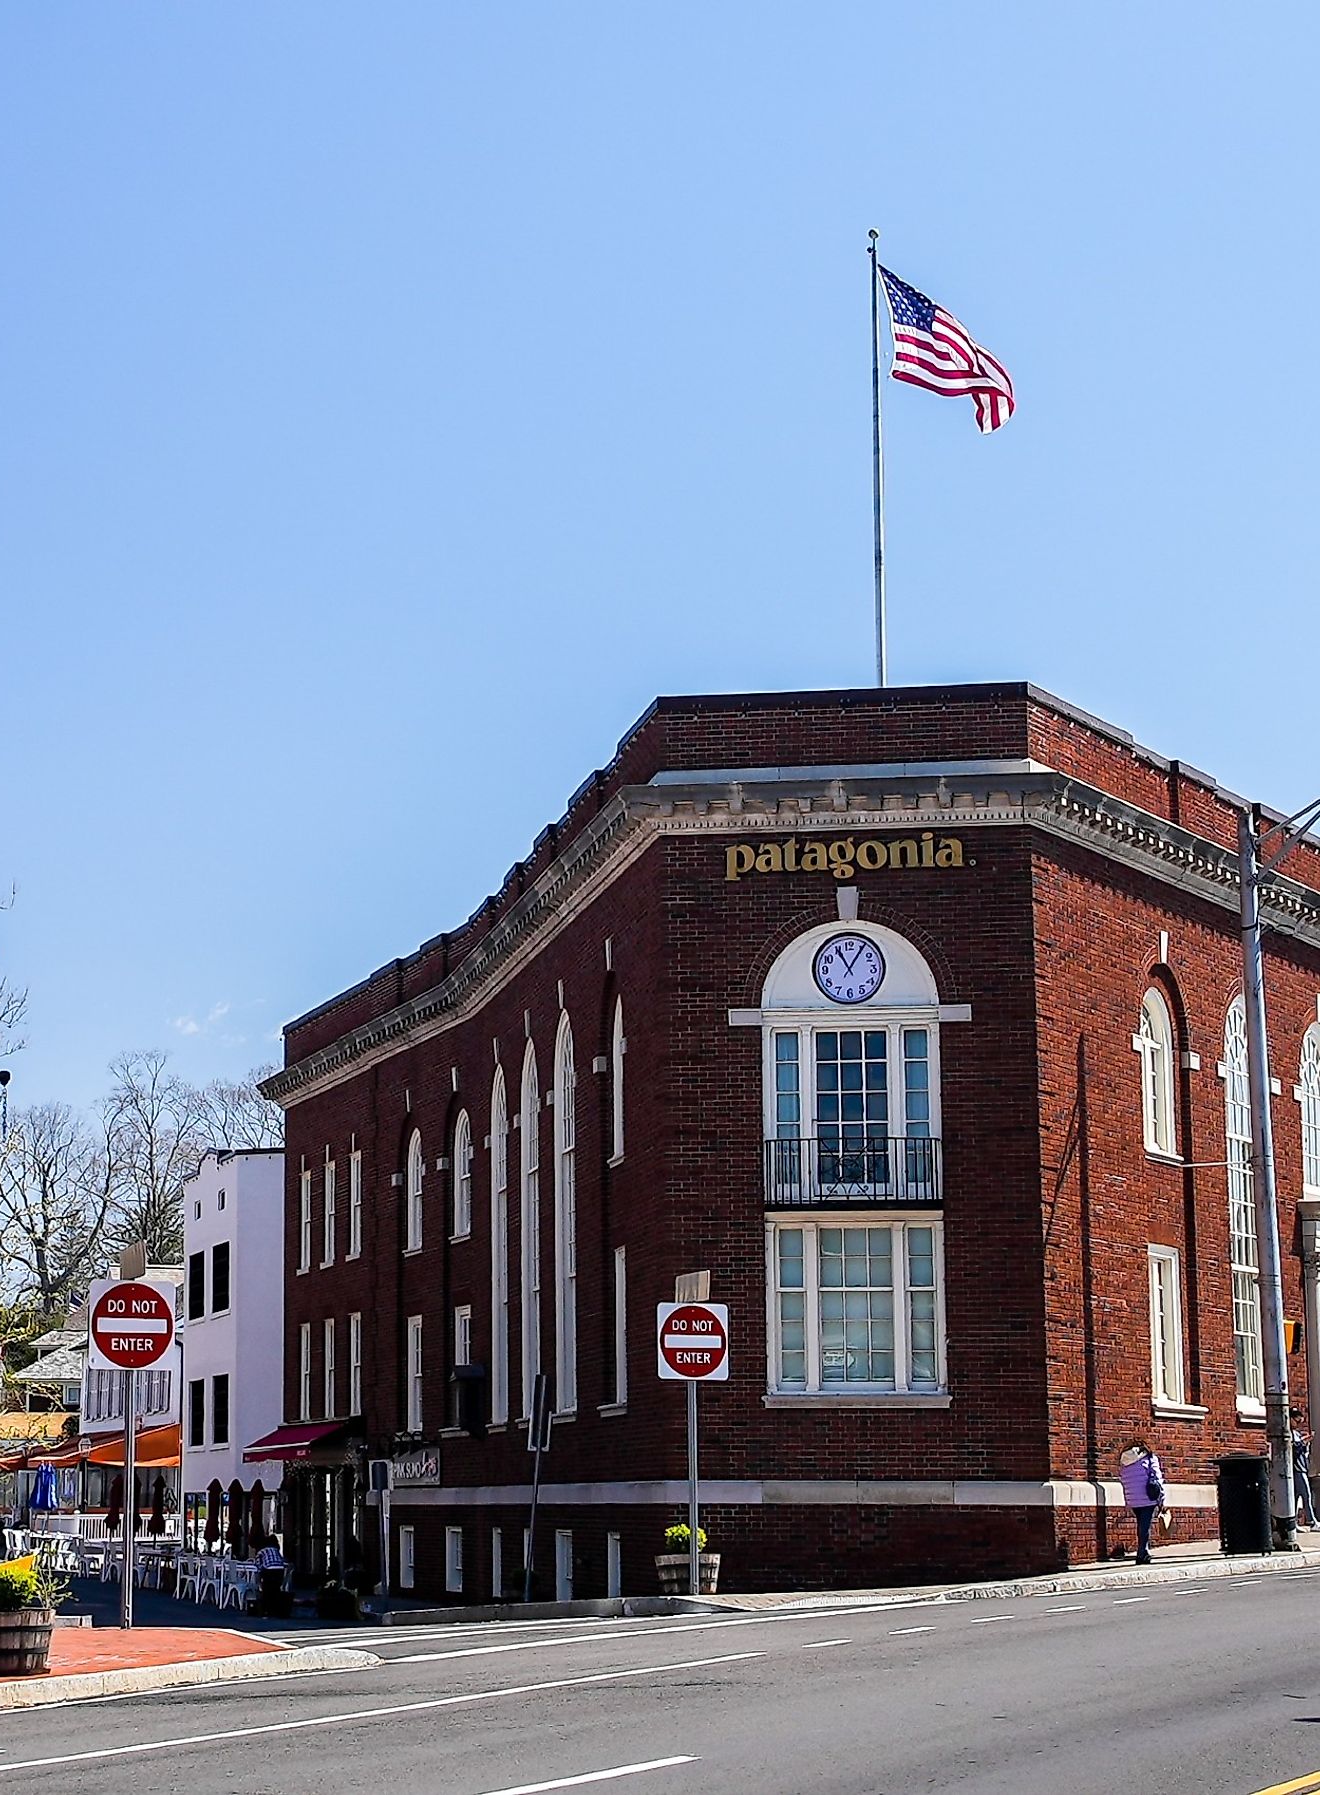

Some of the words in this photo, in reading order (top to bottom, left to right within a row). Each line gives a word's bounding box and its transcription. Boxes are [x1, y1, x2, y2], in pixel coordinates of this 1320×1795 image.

[725, 832, 966, 881] patagonia
[845, 941, 854, 951] 12
[824, 954, 833, 964] 10
[822, 966, 829, 975] 9
[870, 964, 877, 974] 3
[825, 978, 833, 987] 8
[835, 986, 842, 995] 7
[846, 988, 854, 998] 6
[859, 985, 866, 994] 5
[107, 1299, 126, 1313] DO
[131, 1300, 158, 1314] NOT
[671, 1319, 688, 1331] DO
[691, 1320, 714, 1332] NOT
[111, 1337, 154, 1352] ENTER
[675, 1351, 711, 1364] ENTER
